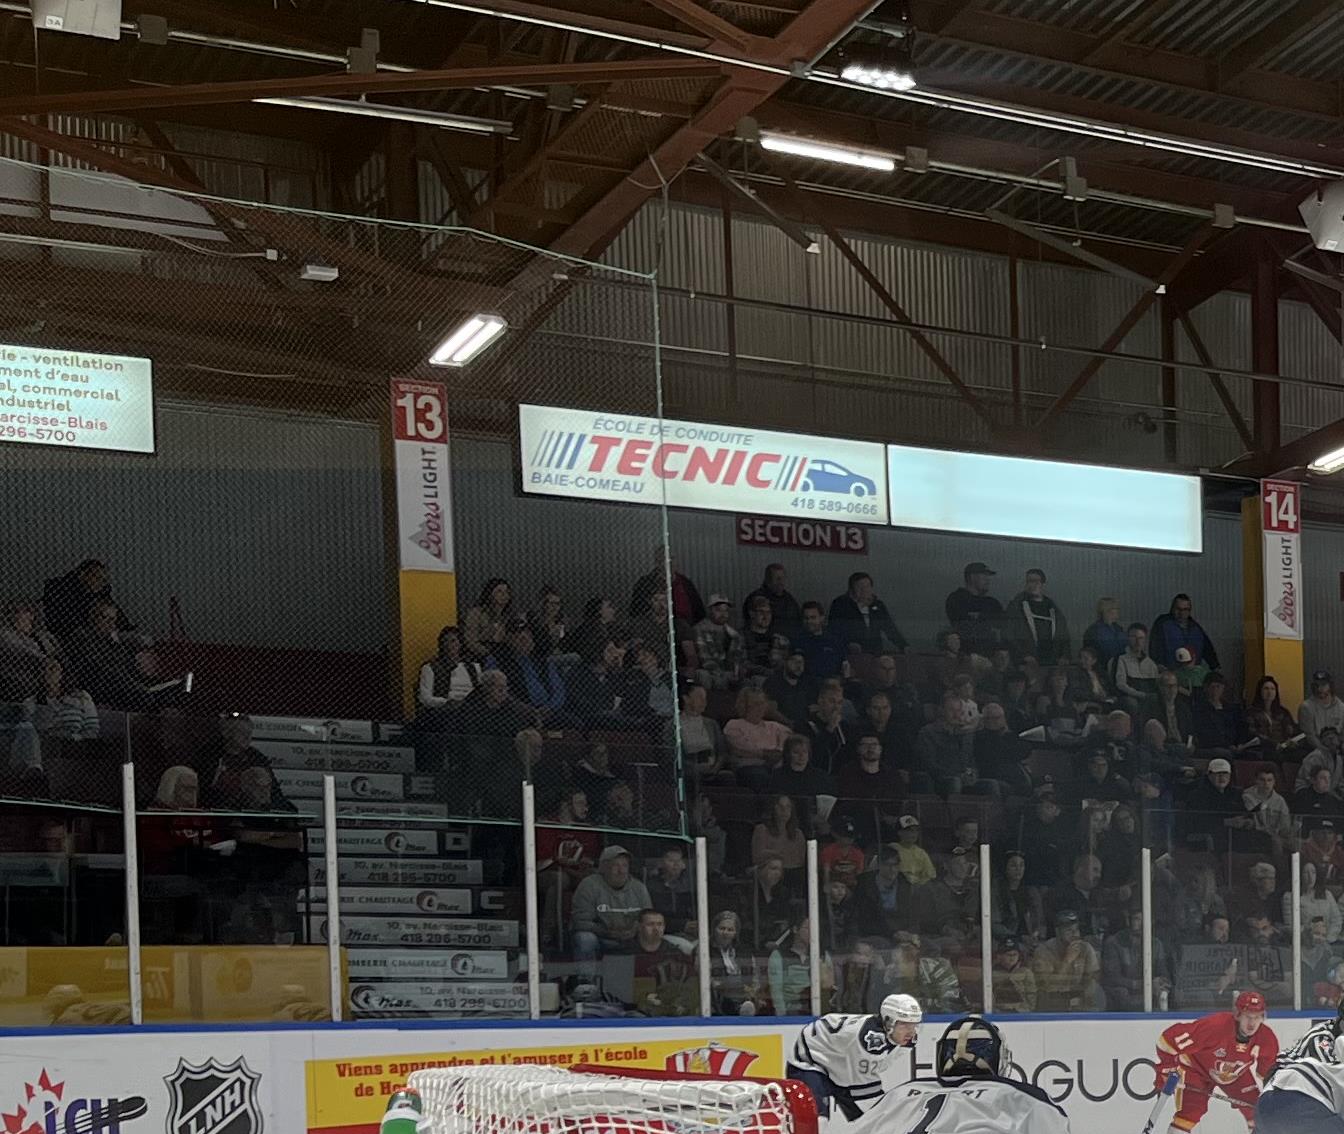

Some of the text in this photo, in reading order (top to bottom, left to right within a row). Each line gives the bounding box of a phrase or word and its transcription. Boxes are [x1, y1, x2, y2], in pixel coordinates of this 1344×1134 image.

[32, 353, 124, 372] ventilation
[45, 367, 90, 384] d'eau
[22, 383, 121, 402] commercial
[396, 392, 444, 440] 13
[592, 416, 754, 448] ÉCOLE DE CONDUITE
[421, 447, 438, 499] LIGHT
[586, 435, 782, 490] TECNIC
[530, 471, 645, 494] BAIE-COMEAU
[790, 497, 878, 516] 418 589-0666
[1264, 491, 1297, 529] 14
[740, 518, 865, 550] SECTION 13
[1281, 536, 1293, 579] LIGHT
[1174, 1032, 1195, 1050] 11
[336, 1063, 383, 1077] Viens
[594, 1047, 648, 1062] l'école
[354, 1083, 374, 1098] de
